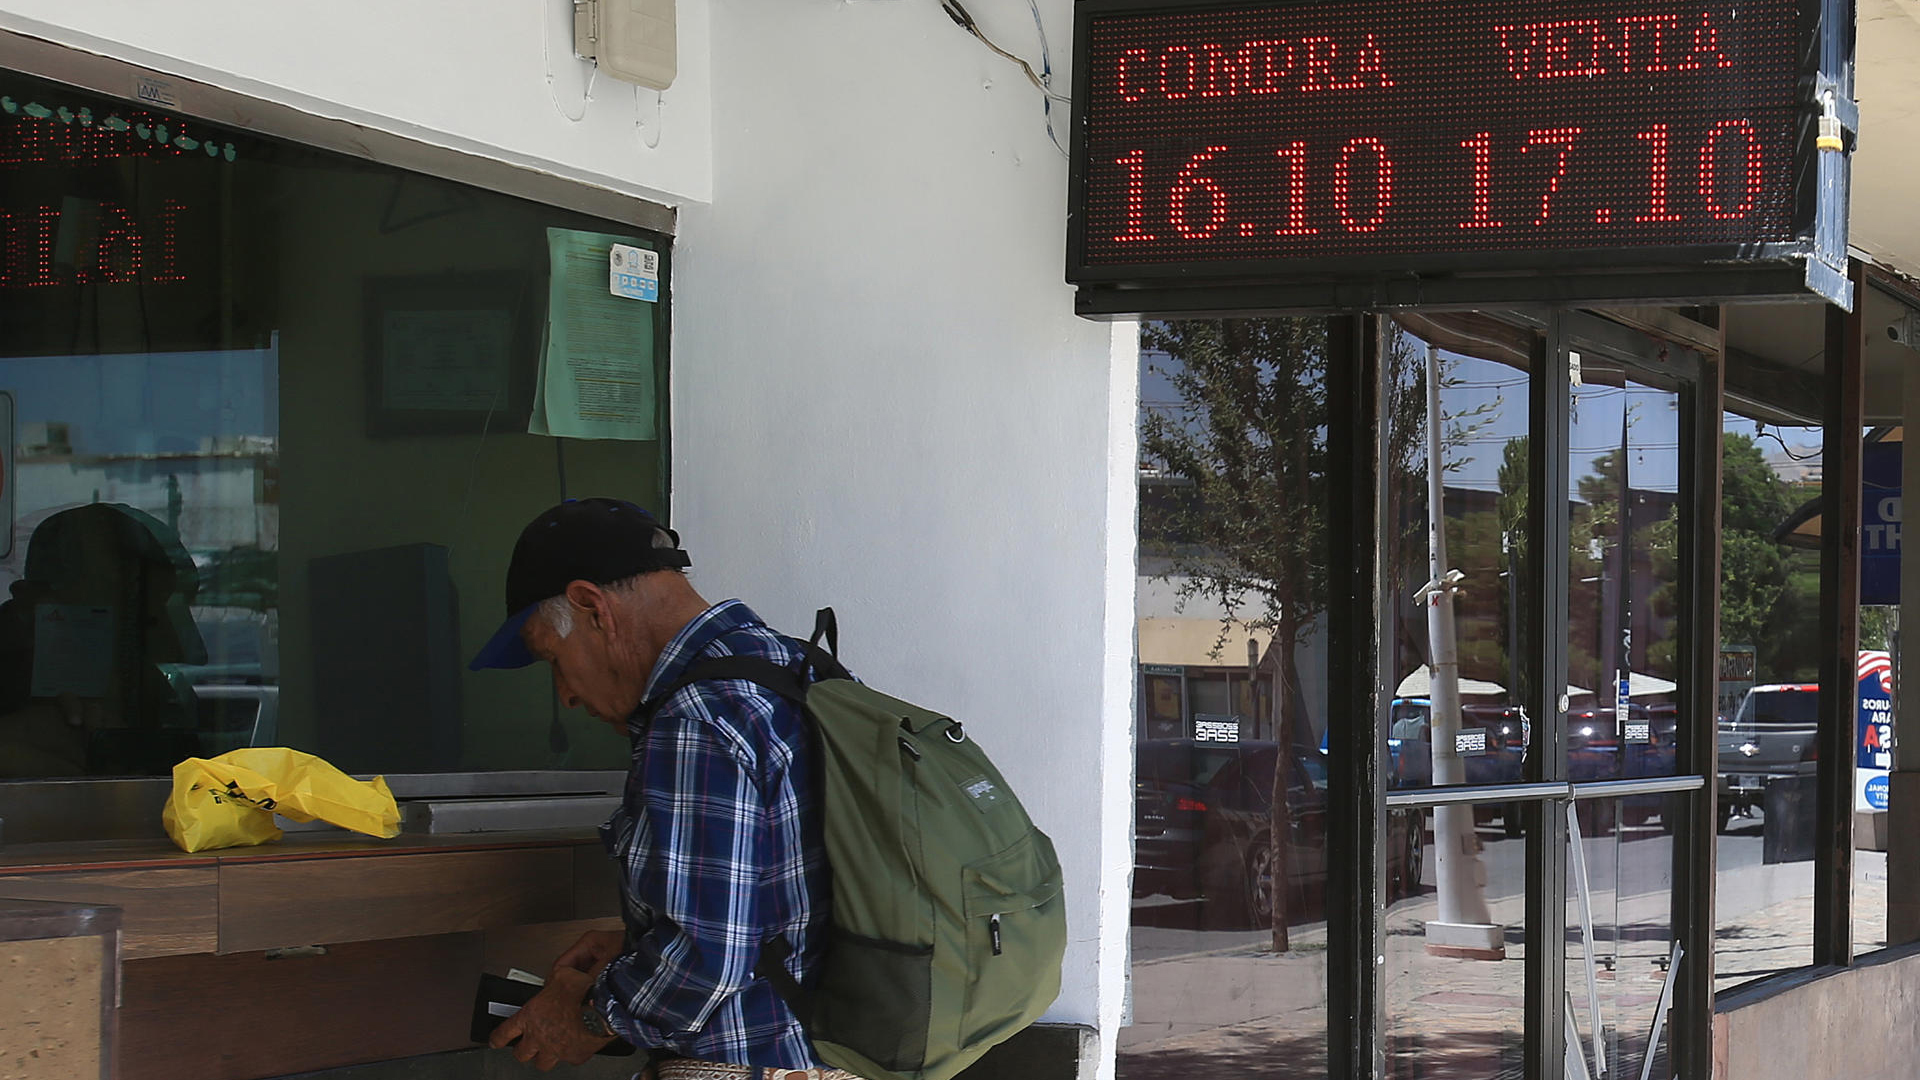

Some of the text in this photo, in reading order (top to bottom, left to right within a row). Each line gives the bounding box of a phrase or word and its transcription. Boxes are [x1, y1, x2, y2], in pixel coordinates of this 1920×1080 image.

[1118, 11, 1733, 103] COMPRA VENTA
[1112, 118, 1763, 243] 16.10 17.10
